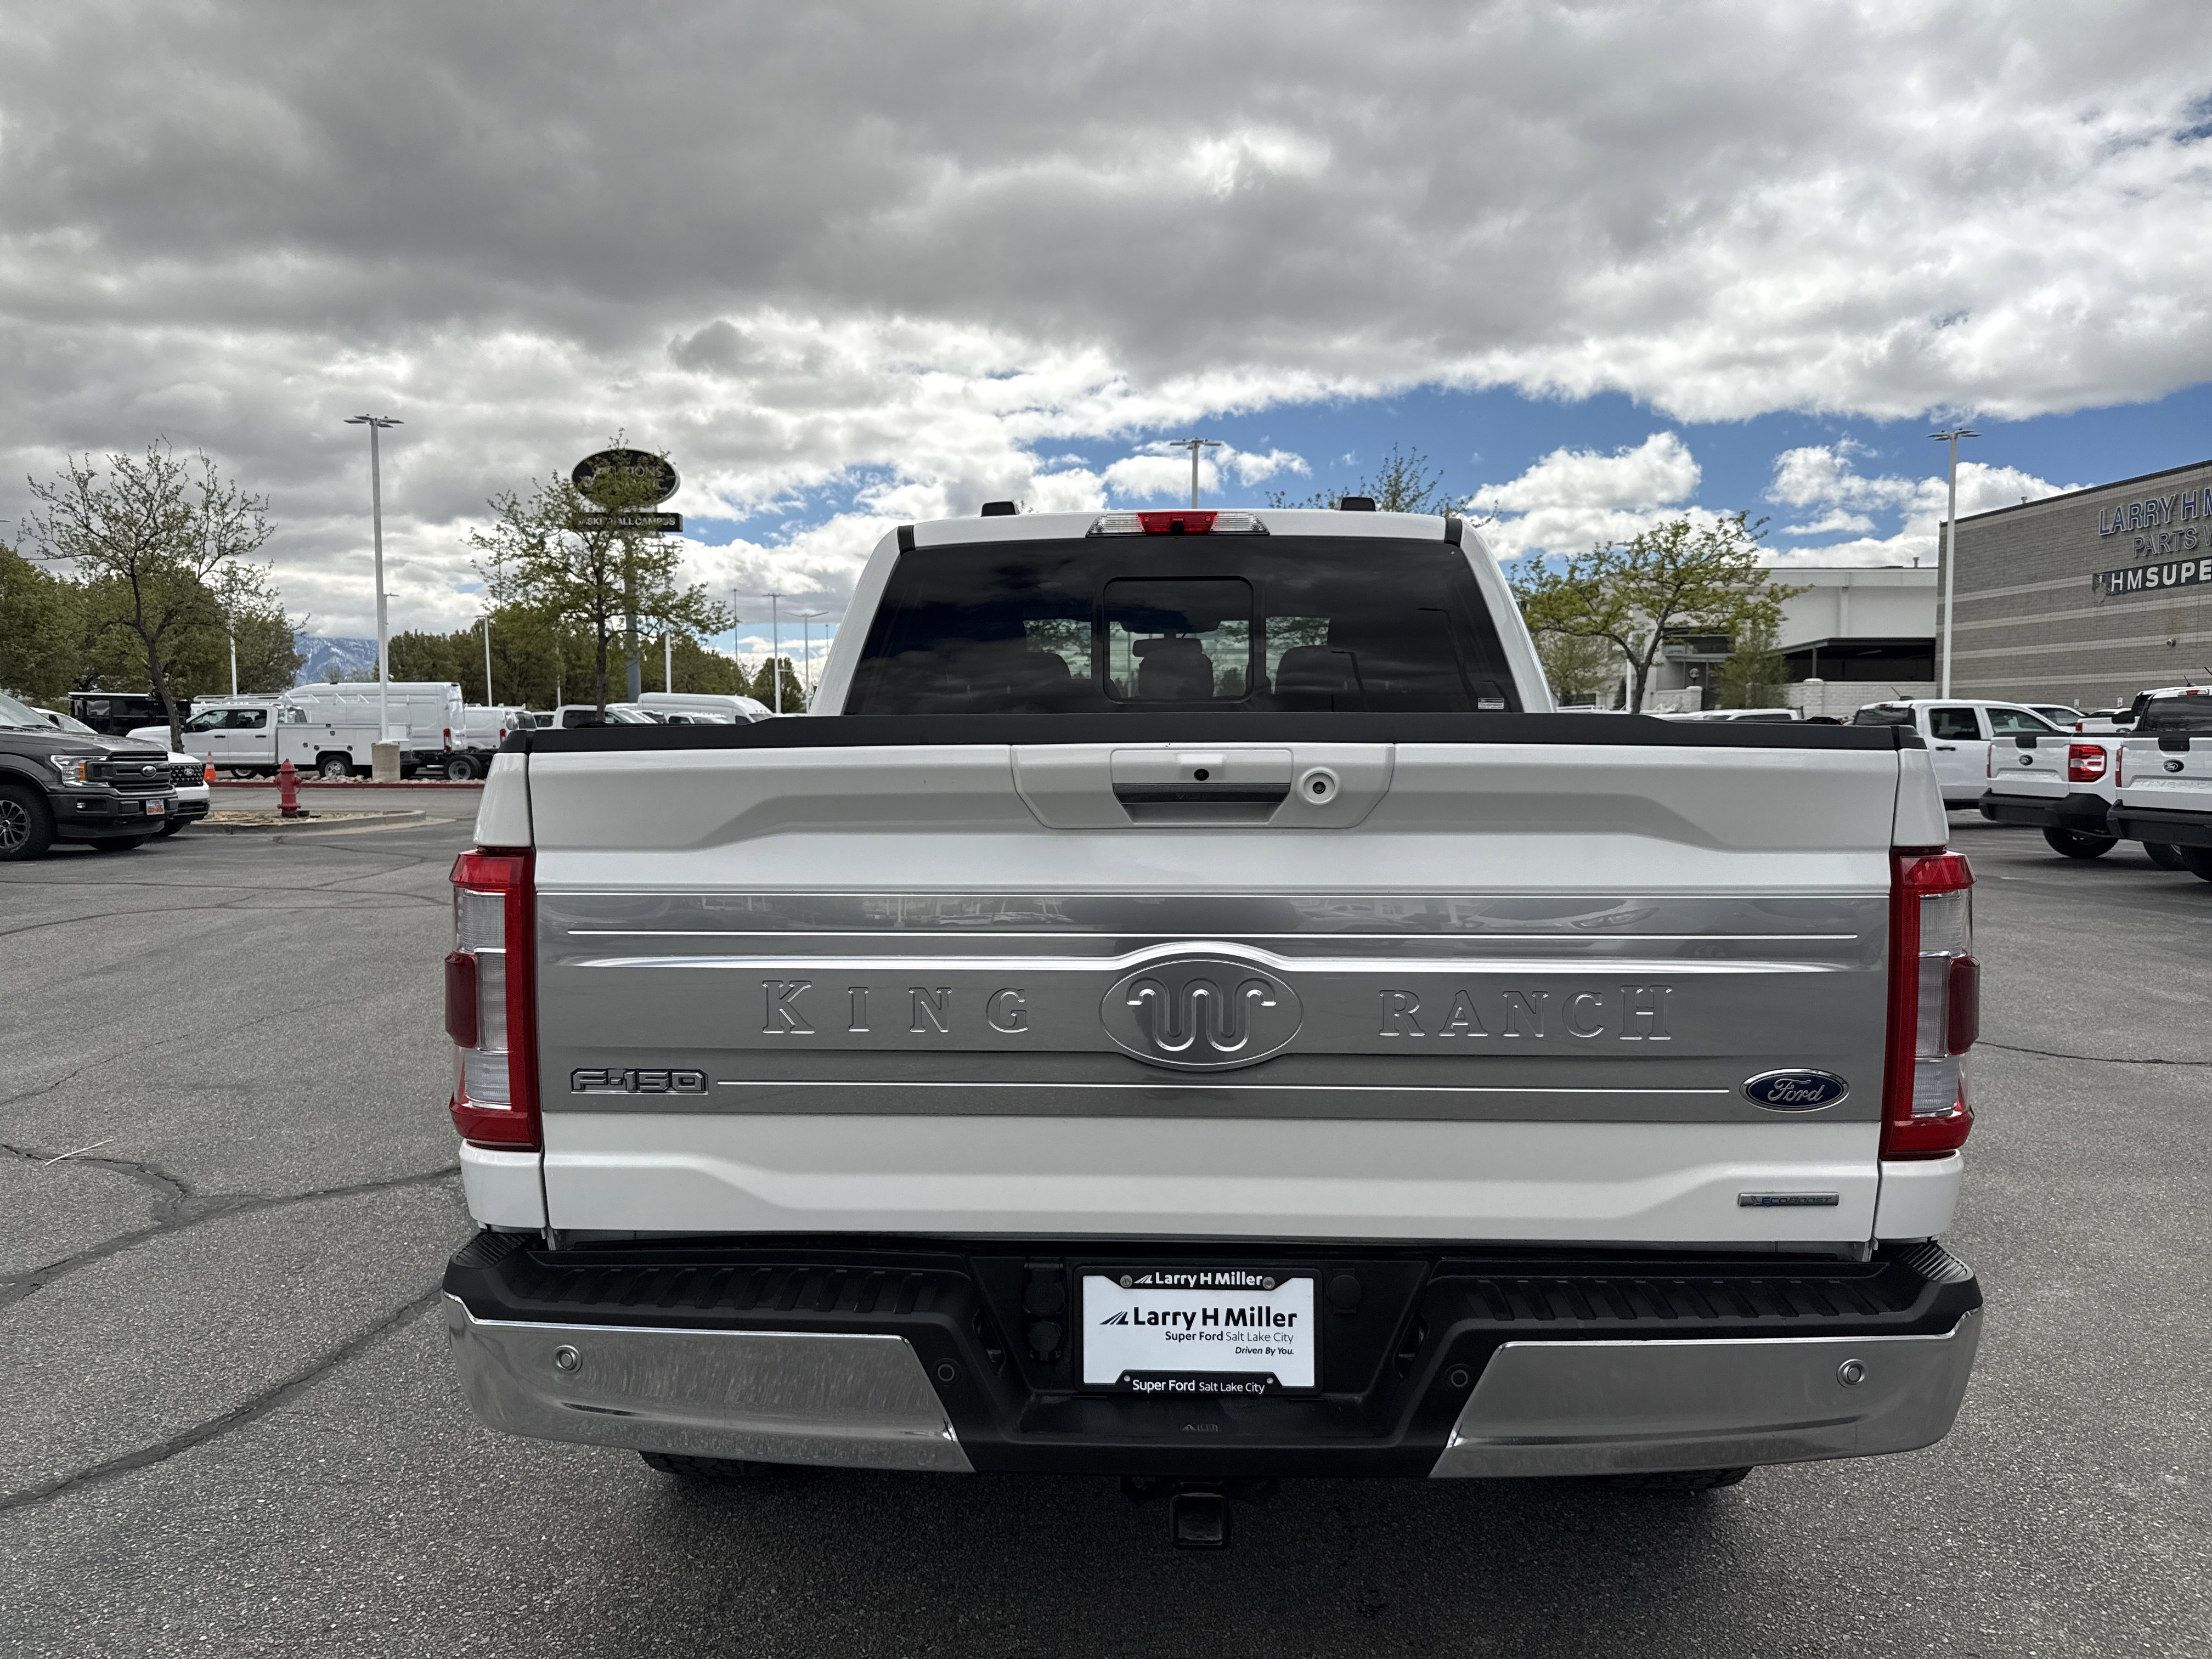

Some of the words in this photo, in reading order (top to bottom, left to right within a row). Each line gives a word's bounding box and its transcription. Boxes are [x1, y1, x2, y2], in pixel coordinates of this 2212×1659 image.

[2098, 494, 2177, 536] LARRY
[2181, 490, 2198, 521] H
[2132, 527, 2198, 558] PARTS
[761, 980, 1029, 1035] KING
[1379, 984, 1673, 1041] RANCH
[571, 1068, 709, 1093] F-150
[1767, 1077, 1826, 1102] Ford
[1155, 1272, 1197, 1288] Larry
[1200, 1272, 1212, 1285] H
[1215, 1271, 1263, 1285] Miller
[1133, 1306, 1197, 1331] Larry
[1201, 1307, 1218, 1326] H
[1224, 1306, 1297, 1327] Miller
[1165, 1331, 1197, 1342] Super
[1199, 1331, 1223, 1341] Ford
[1226, 1331, 1244, 1341] Salt
[1247, 1331, 1271, 1342] Lake
[1273, 1332, 1294, 1344] City
[1235, 1346, 1262, 1355] Driven
[1265, 1347, 1276, 1356] By
[1132, 1379, 1166, 1393] Super
[1169, 1380, 1195, 1391] Ford
[1199, 1382, 1218, 1392] Salt
[1220, 1383, 1243, 1392] Lake
[1245, 1382, 1265, 1395] City
